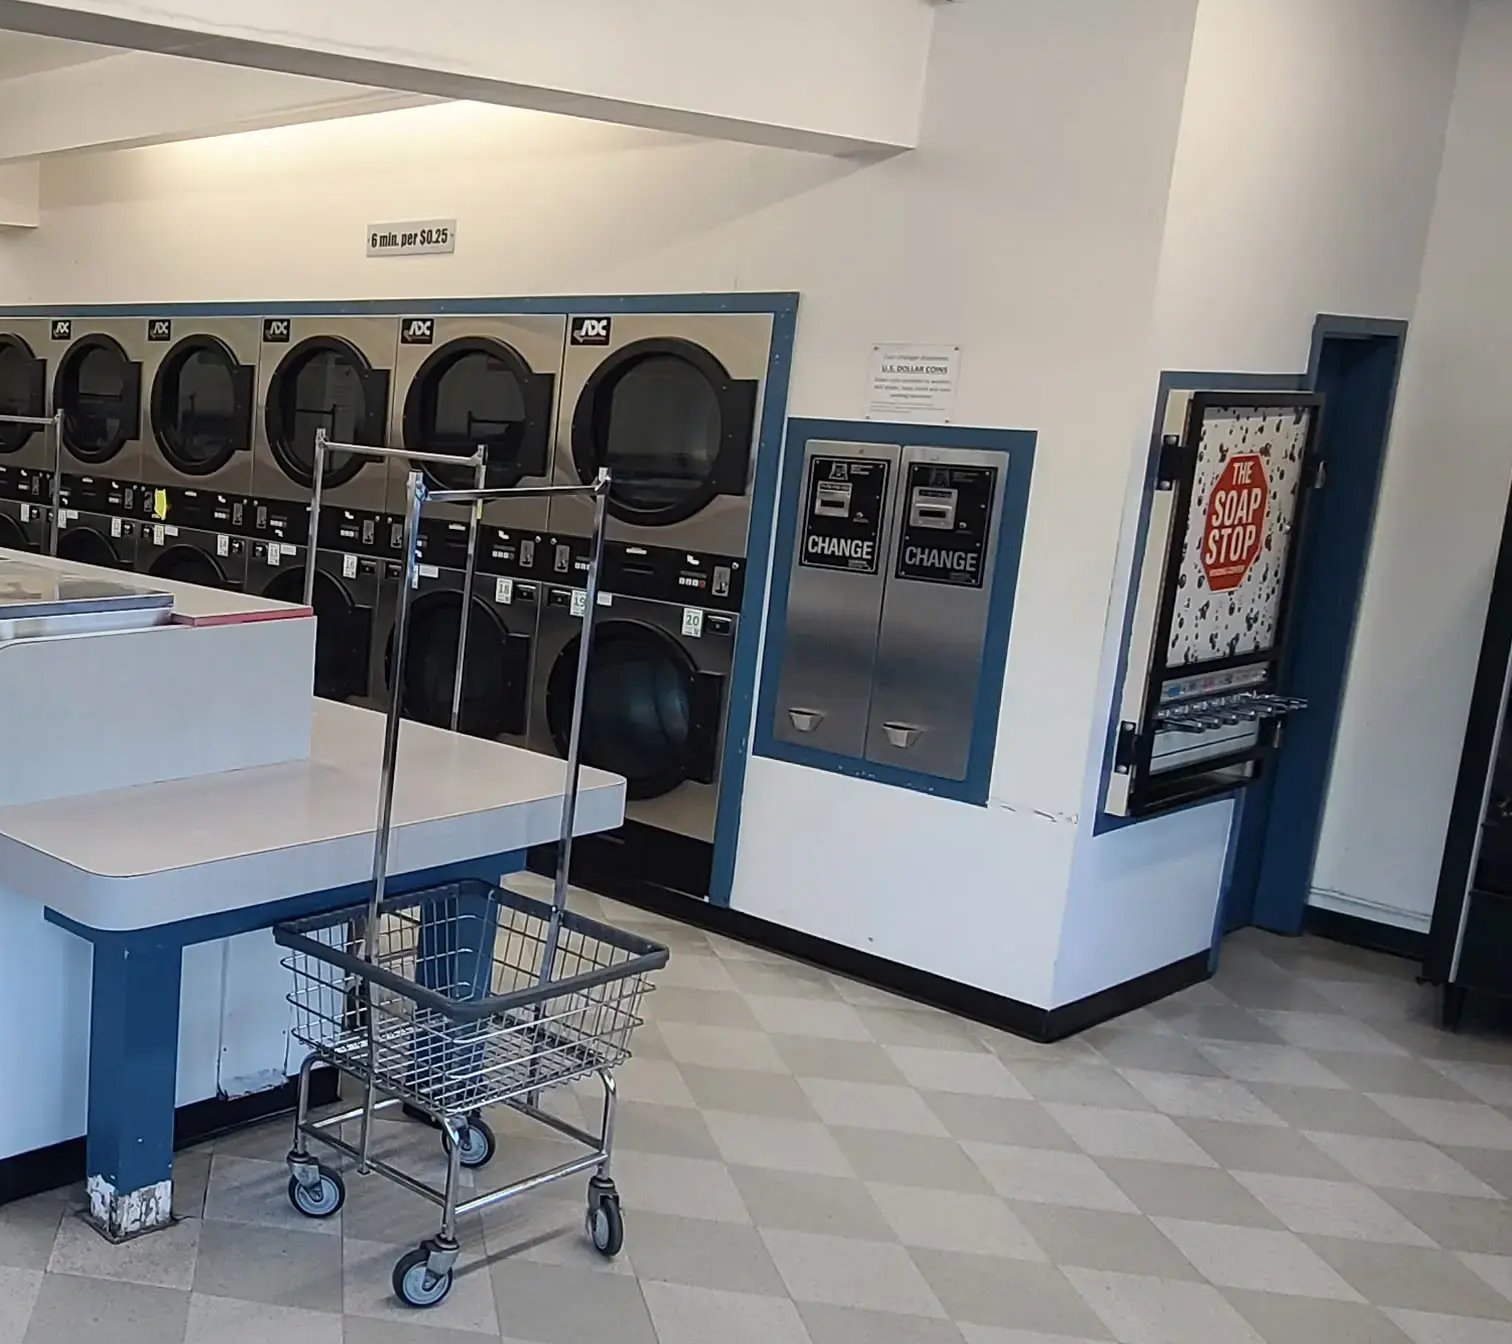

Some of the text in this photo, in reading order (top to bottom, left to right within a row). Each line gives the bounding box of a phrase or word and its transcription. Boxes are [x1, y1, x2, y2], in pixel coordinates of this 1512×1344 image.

[371, 228, 448, 248] 6 min. per $0.25
[409, 320, 432, 336] ADC
[580, 319, 608, 336] ADC
[881, 364, 948, 375] U.S. DOLLAR COINS
[1232, 460, 1256, 485] THE
[1210, 487, 1263, 528] SOAP
[807, 534, 874, 560] CHANGE
[1205, 524, 1257, 566] STOP
[904, 545, 978, 572] CHANGE
[499, 582, 510, 595] 18
[685, 614, 700, 627] 20
